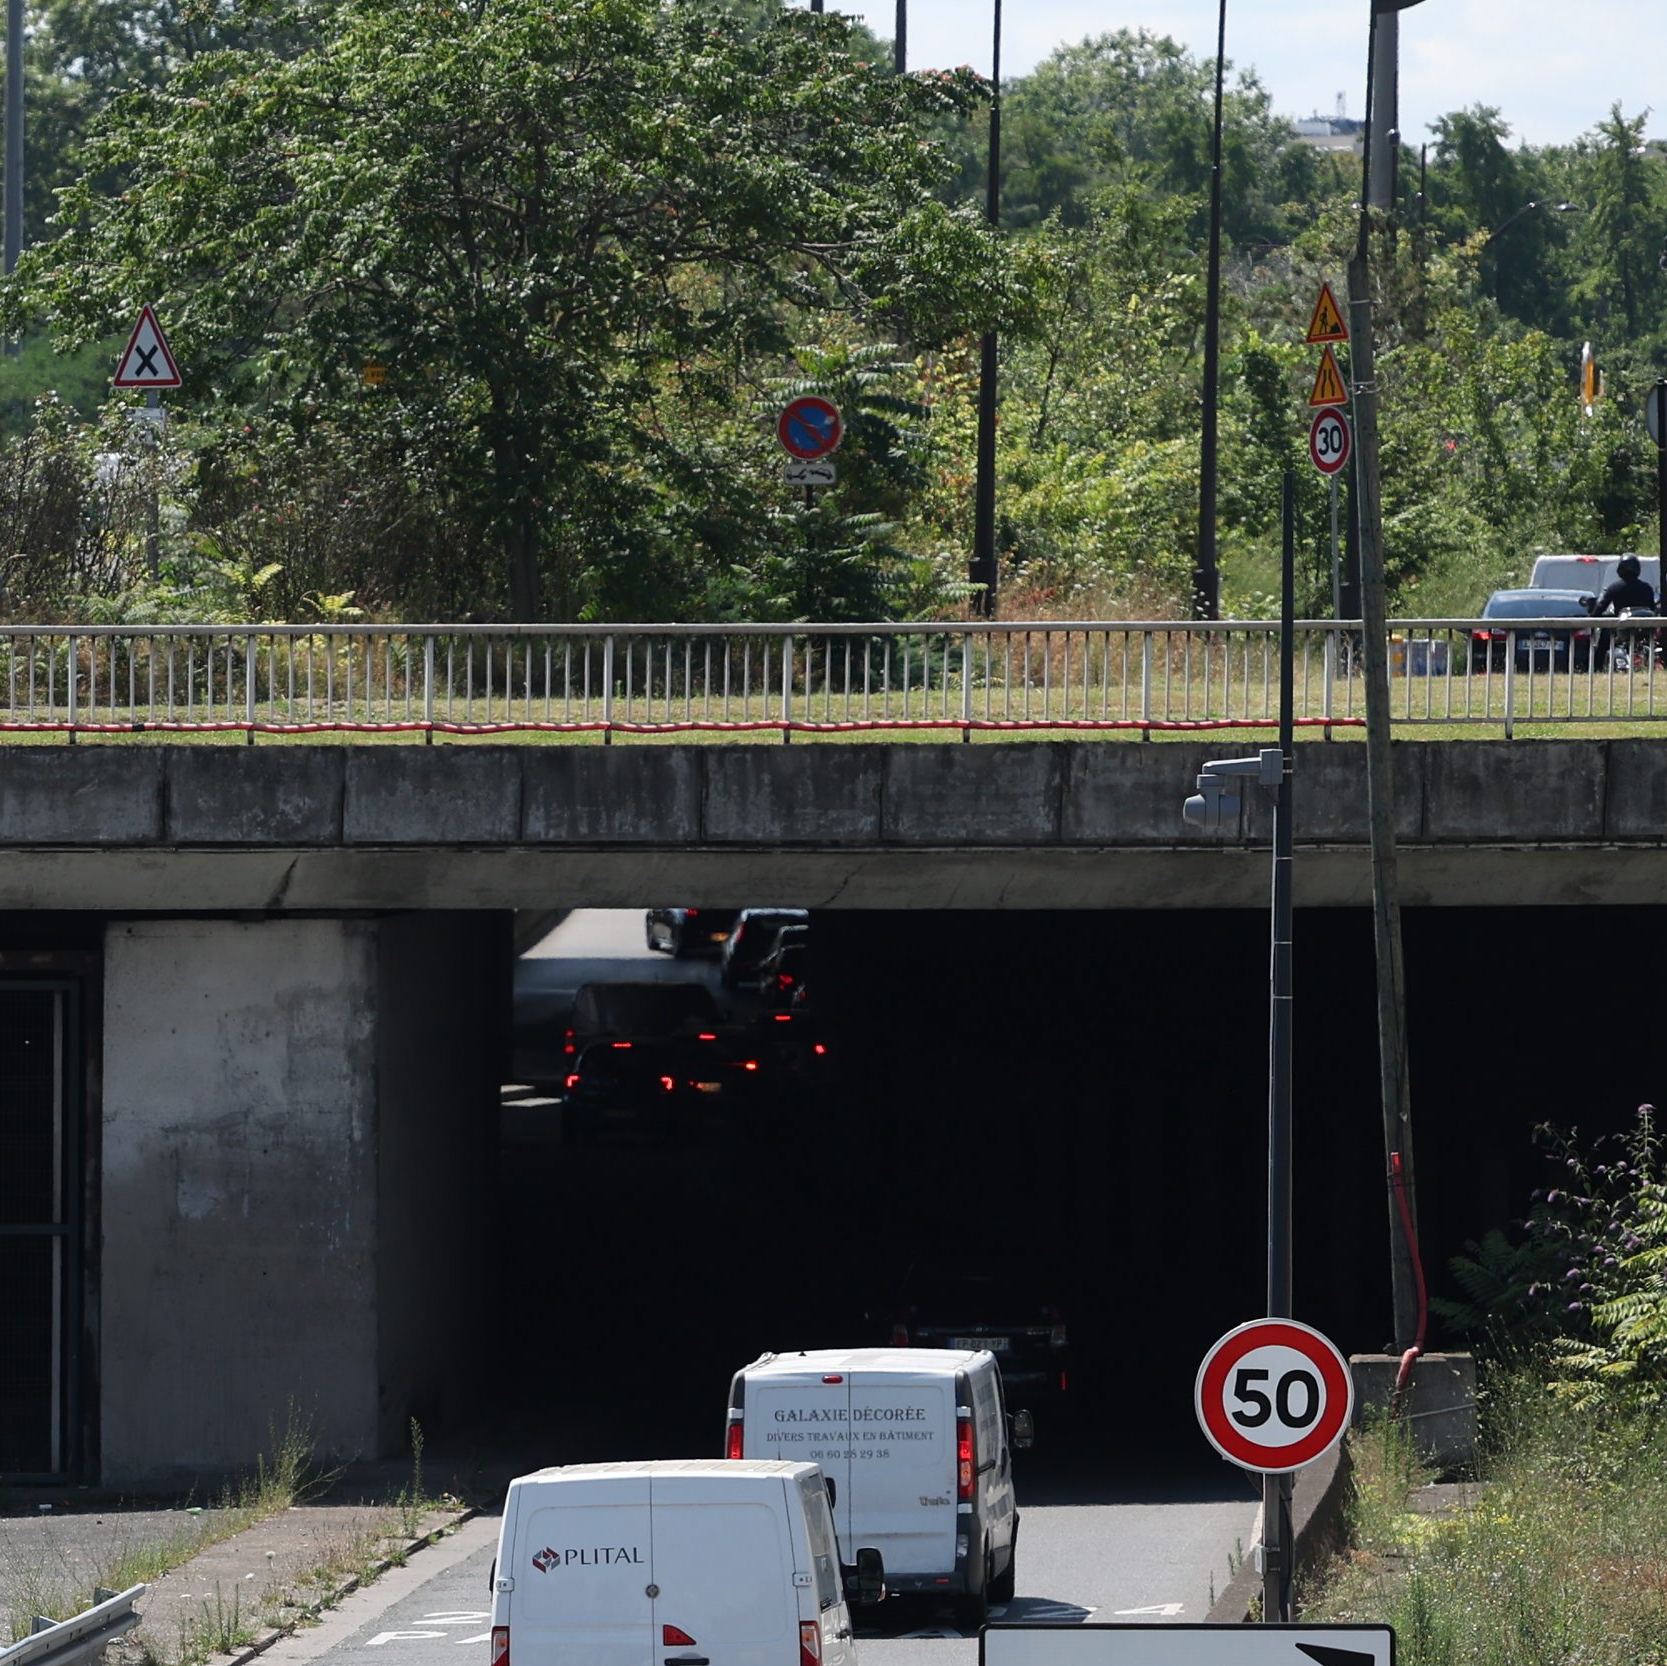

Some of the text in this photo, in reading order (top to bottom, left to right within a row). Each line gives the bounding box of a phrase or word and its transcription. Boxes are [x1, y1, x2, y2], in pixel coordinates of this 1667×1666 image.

[1318, 425, 1342, 455] 30
[1230, 1368, 1320, 1430] 50
[773, 1405, 927, 1422] GALAXIE DÉCORÉE
[765, 1429, 935, 1442] DIVERS TRAVAUX EN BÂTIMENT
[810, 1450, 824, 1459] 06
[827, 1450, 841, 1459] 60
[859, 1449, 873, 1458] 29
[564, 1546, 646, 1566] PLITAL
